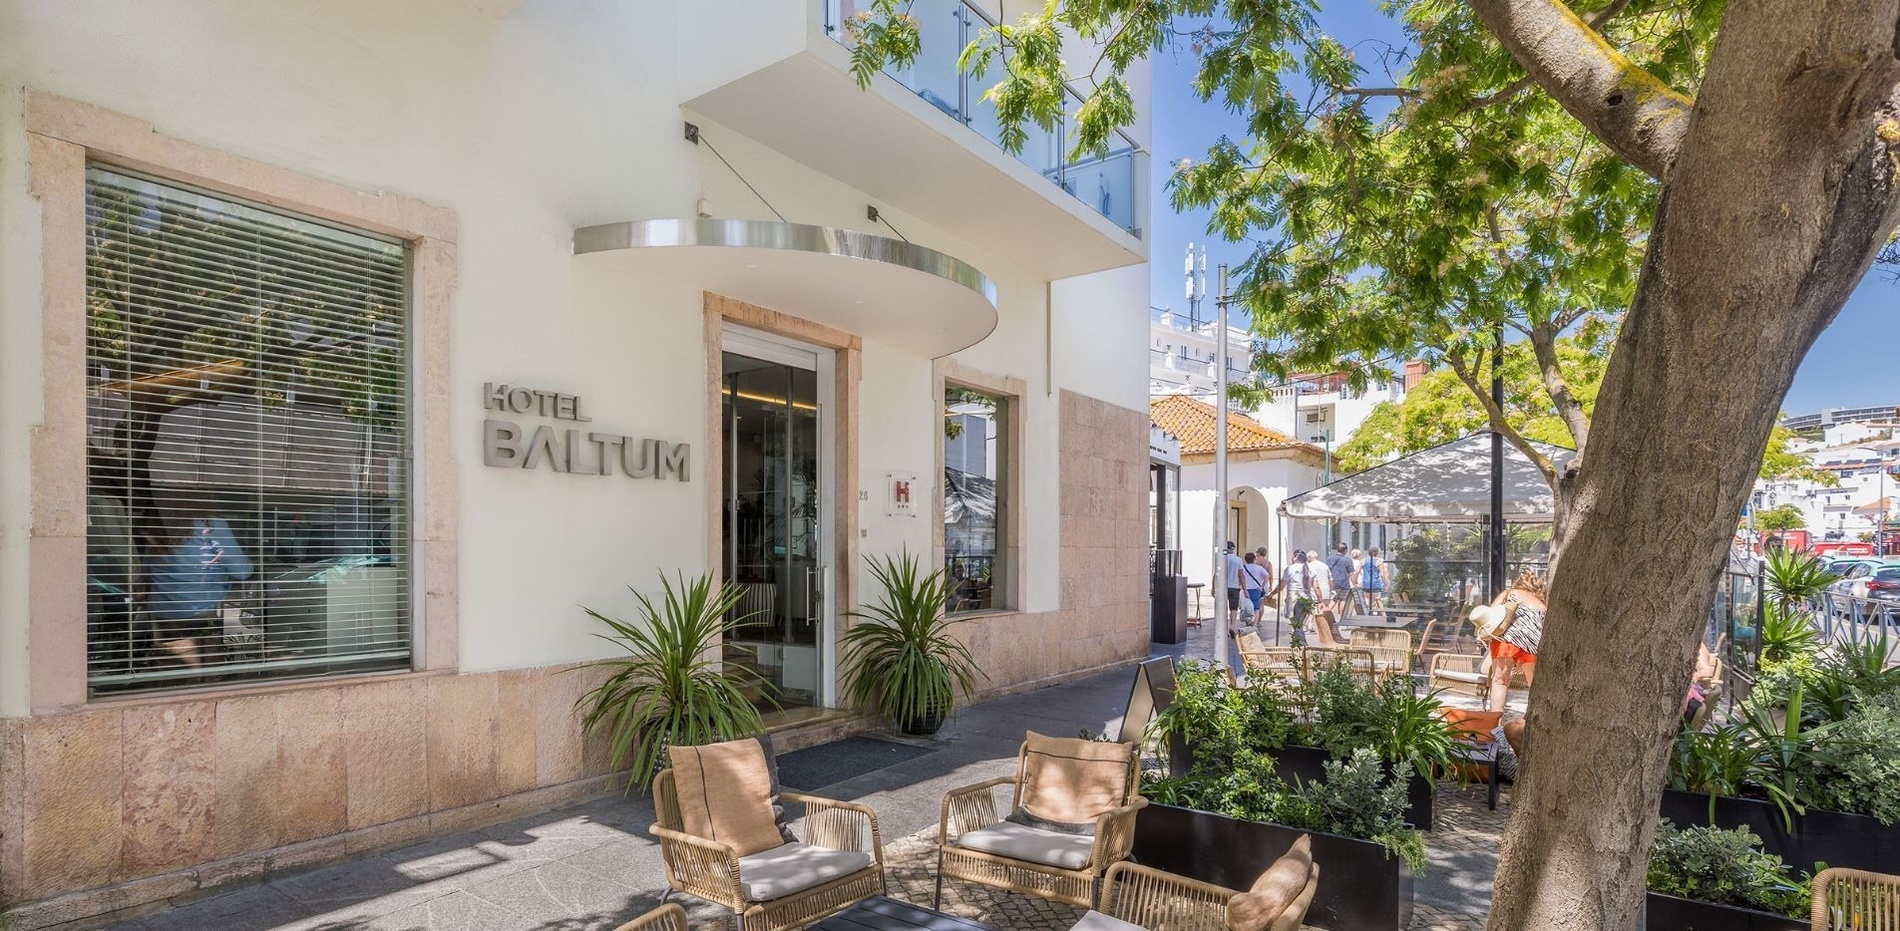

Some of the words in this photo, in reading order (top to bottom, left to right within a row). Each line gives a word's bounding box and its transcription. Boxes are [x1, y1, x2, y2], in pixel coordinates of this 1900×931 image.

[483, 382, 592, 422] HOTEL
[483, 419, 691, 482] BALTUM
[896, 481, 909, 502] H
